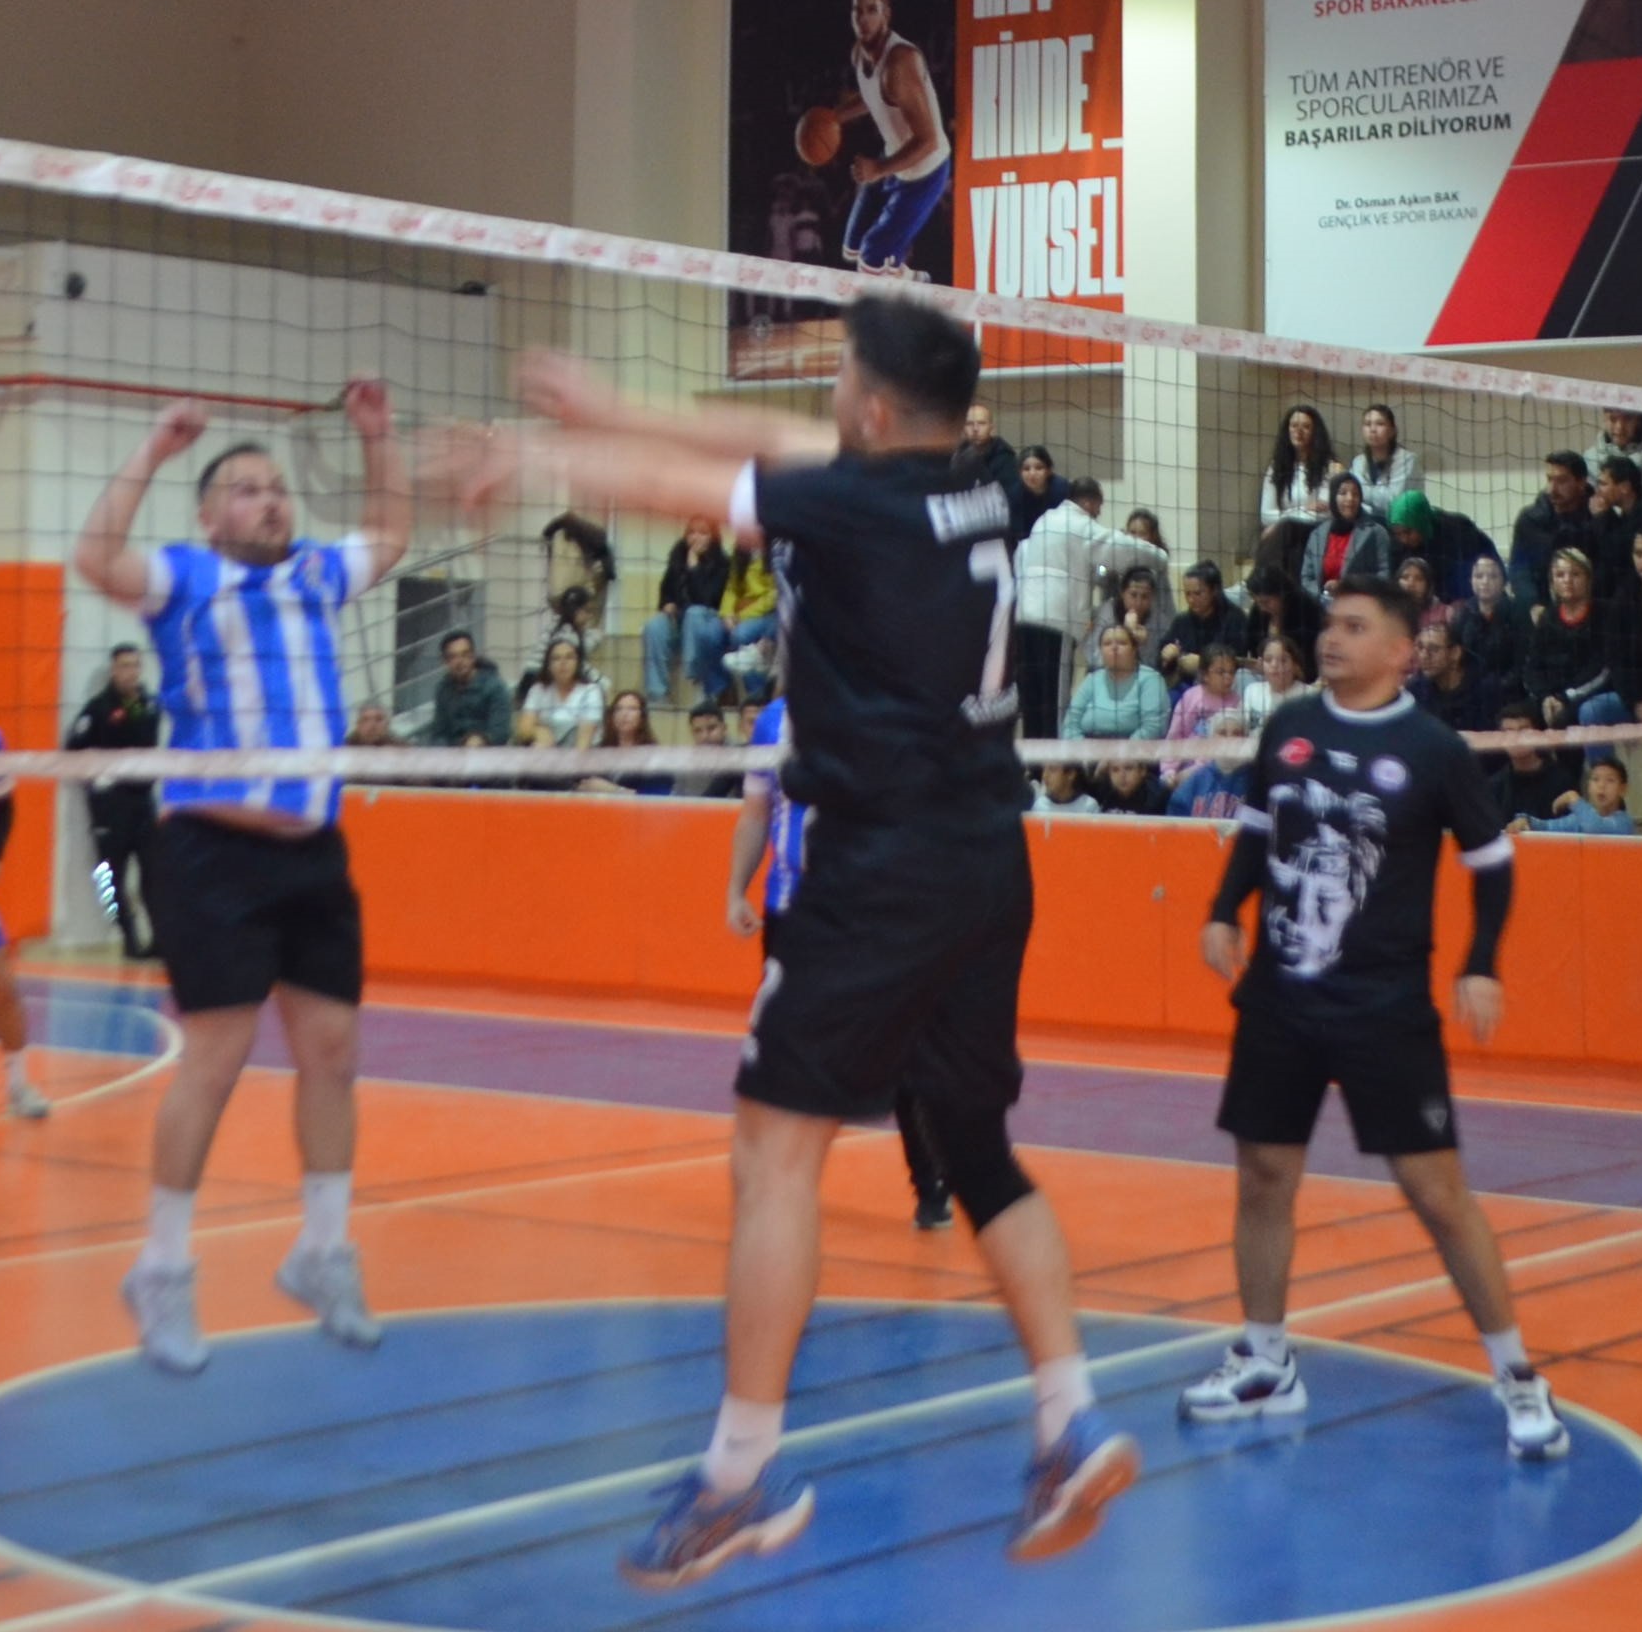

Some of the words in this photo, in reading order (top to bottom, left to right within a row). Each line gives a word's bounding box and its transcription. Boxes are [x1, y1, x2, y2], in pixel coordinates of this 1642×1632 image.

[1289, 70, 1339, 95] TÜM
[1345, 57, 1470, 90] ANTRENÖR
[1477, 56, 1504, 78] VE
[972, 31, 1093, 160] KİNDE
[1296, 84, 1498, 121] SPORCULARIMIZA
[1285, 122, 1393, 149] BAŞARILAR
[1398, 113, 1511, 138] DİLİYORUM
[1354, 197, 1396, 208] Osman
[1434, 191, 1460, 203] BAK
[1374, 212, 1390, 225] VE
[1392, 210, 1426, 224] SPOR
[970, 173, 1124, 299] YÜKSEL
[969, 538, 1014, 701] 7
